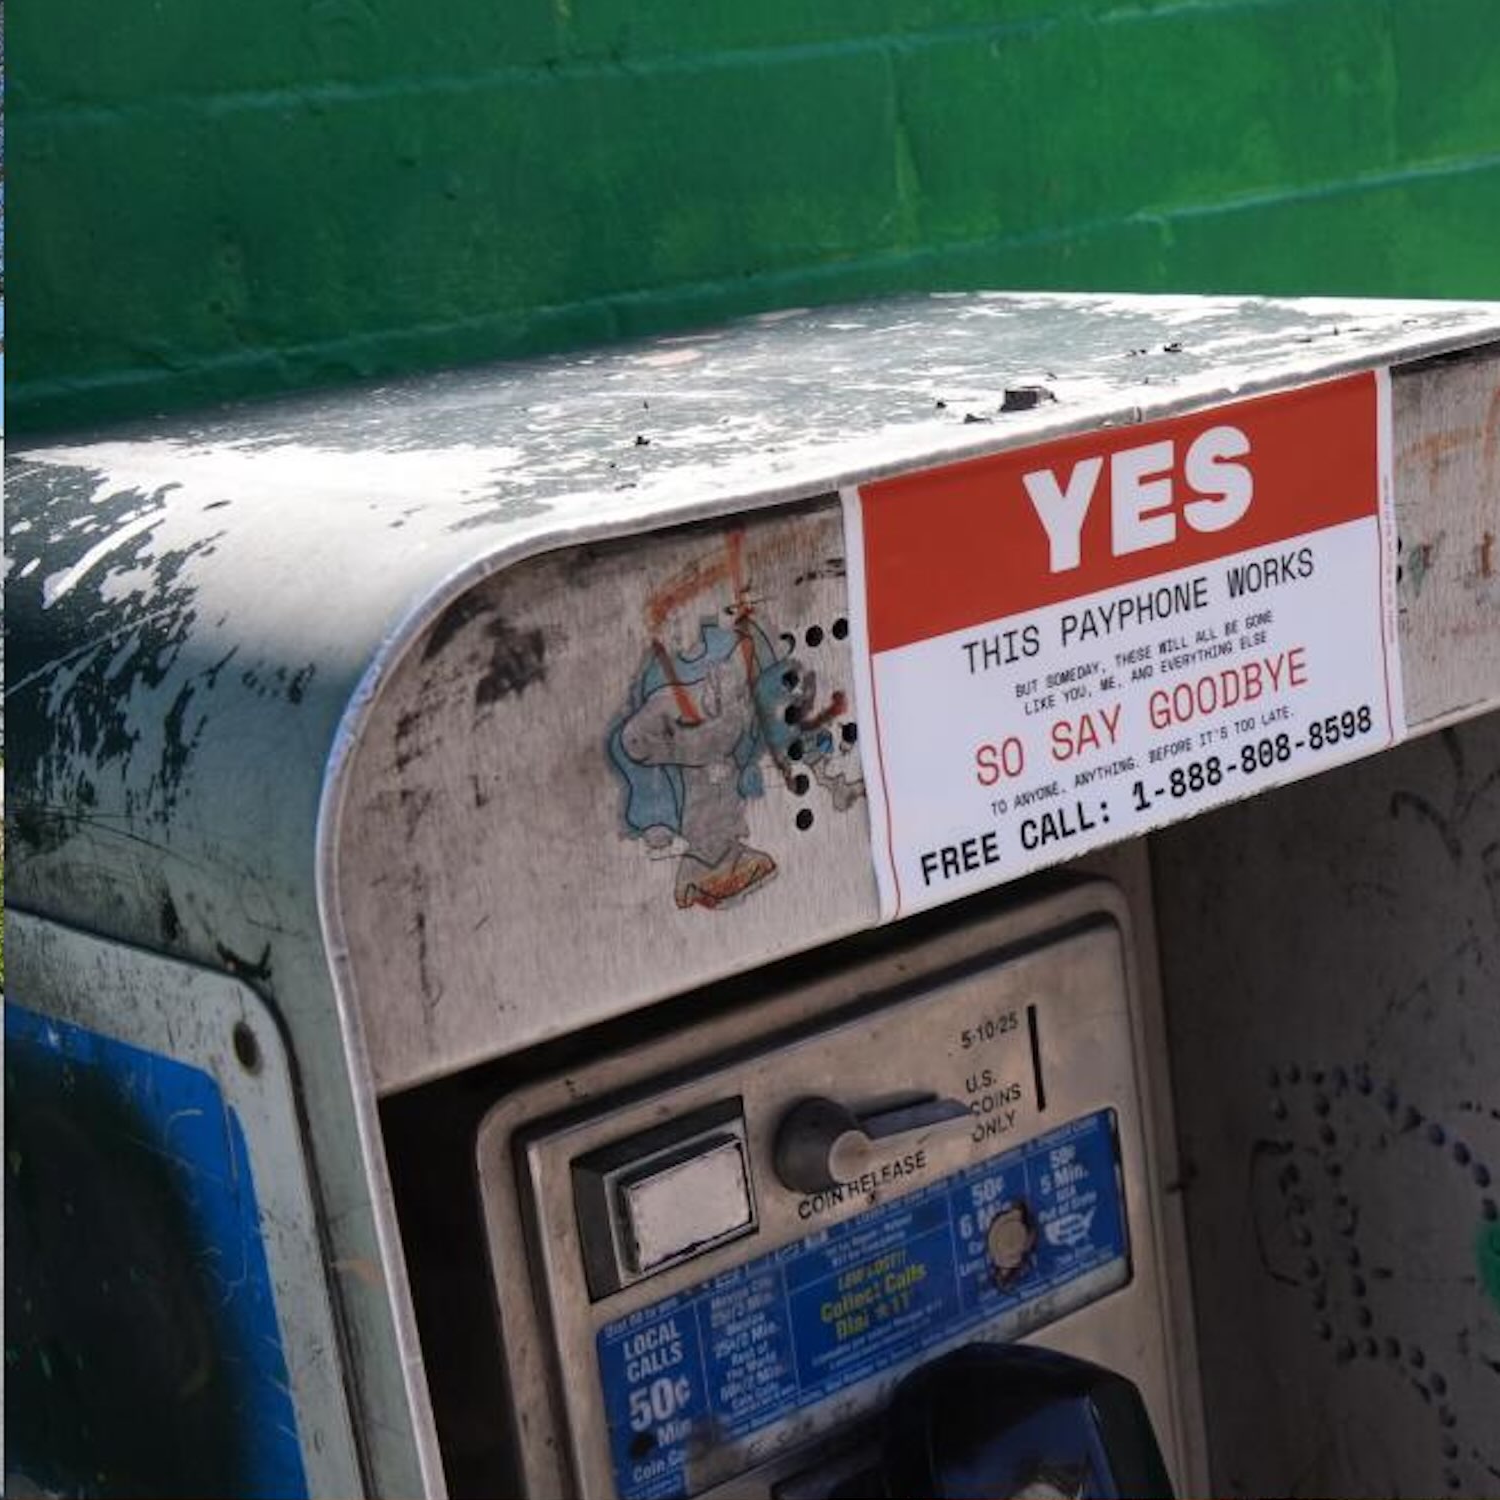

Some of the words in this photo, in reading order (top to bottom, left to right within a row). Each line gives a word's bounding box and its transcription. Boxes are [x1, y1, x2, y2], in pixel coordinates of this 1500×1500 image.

[1023, 426, 1253, 573] YES
[962, 624, 1041, 675] THIS
[1060, 577, 1209, 647] PAYPHONE
[1227, 548, 1315, 599] WORKS
[1015, 679, 1038, 699] BUT
[1046, 661, 1106, 691] SOMEDAY,
[1114, 648, 1152, 665] THESE
[1158, 637, 1188, 656] WILL
[1195, 628, 1219, 647] ALL
[1224, 619, 1240, 637] BE
[1244, 609, 1275, 629] GONE
[1023, 697, 1055, 717] LIKE
[1063, 684, 1093, 704] YOU,
[1130, 664, 1154, 683] AND
[1160, 642, 1234, 674] EVERYTHING
[1240, 630, 1268, 650] ELSE
[975, 738, 1024, 787] SO
[1050, 704, 1123, 763] SAY
[1148, 647, 1308, 729] GOODBYE
[990, 800, 1008, 817] TO
[1148, 738, 1193, 764] BEFORE
[1200, 727, 1229, 747] IT'S
[1234, 718, 1256, 736] TOO
[1262, 706, 1295, 729] LATE.
[920, 831, 1001, 886] FREE
[1020, 799, 1111, 850] CALL:
[1131, 705, 1373, 811] 1-888-808-8598
[966, 1070, 997, 1093] U.S.
[970, 1083, 1022, 1117] COINS
[971, 1111, 1016, 1143] ONLY
[798, 1184, 843, 1220] COIN
[848, 1151, 927, 1196] RELEASE
[960, 1214, 973, 1240] 6
[884, 1264, 928, 1294] Calls
[622, 1319, 681, 1362] LOCAL
[627, 1341, 684, 1384] CALLS
[629, 1374, 692, 1433] 50¢
[633, 1459, 667, 1483] Coin
